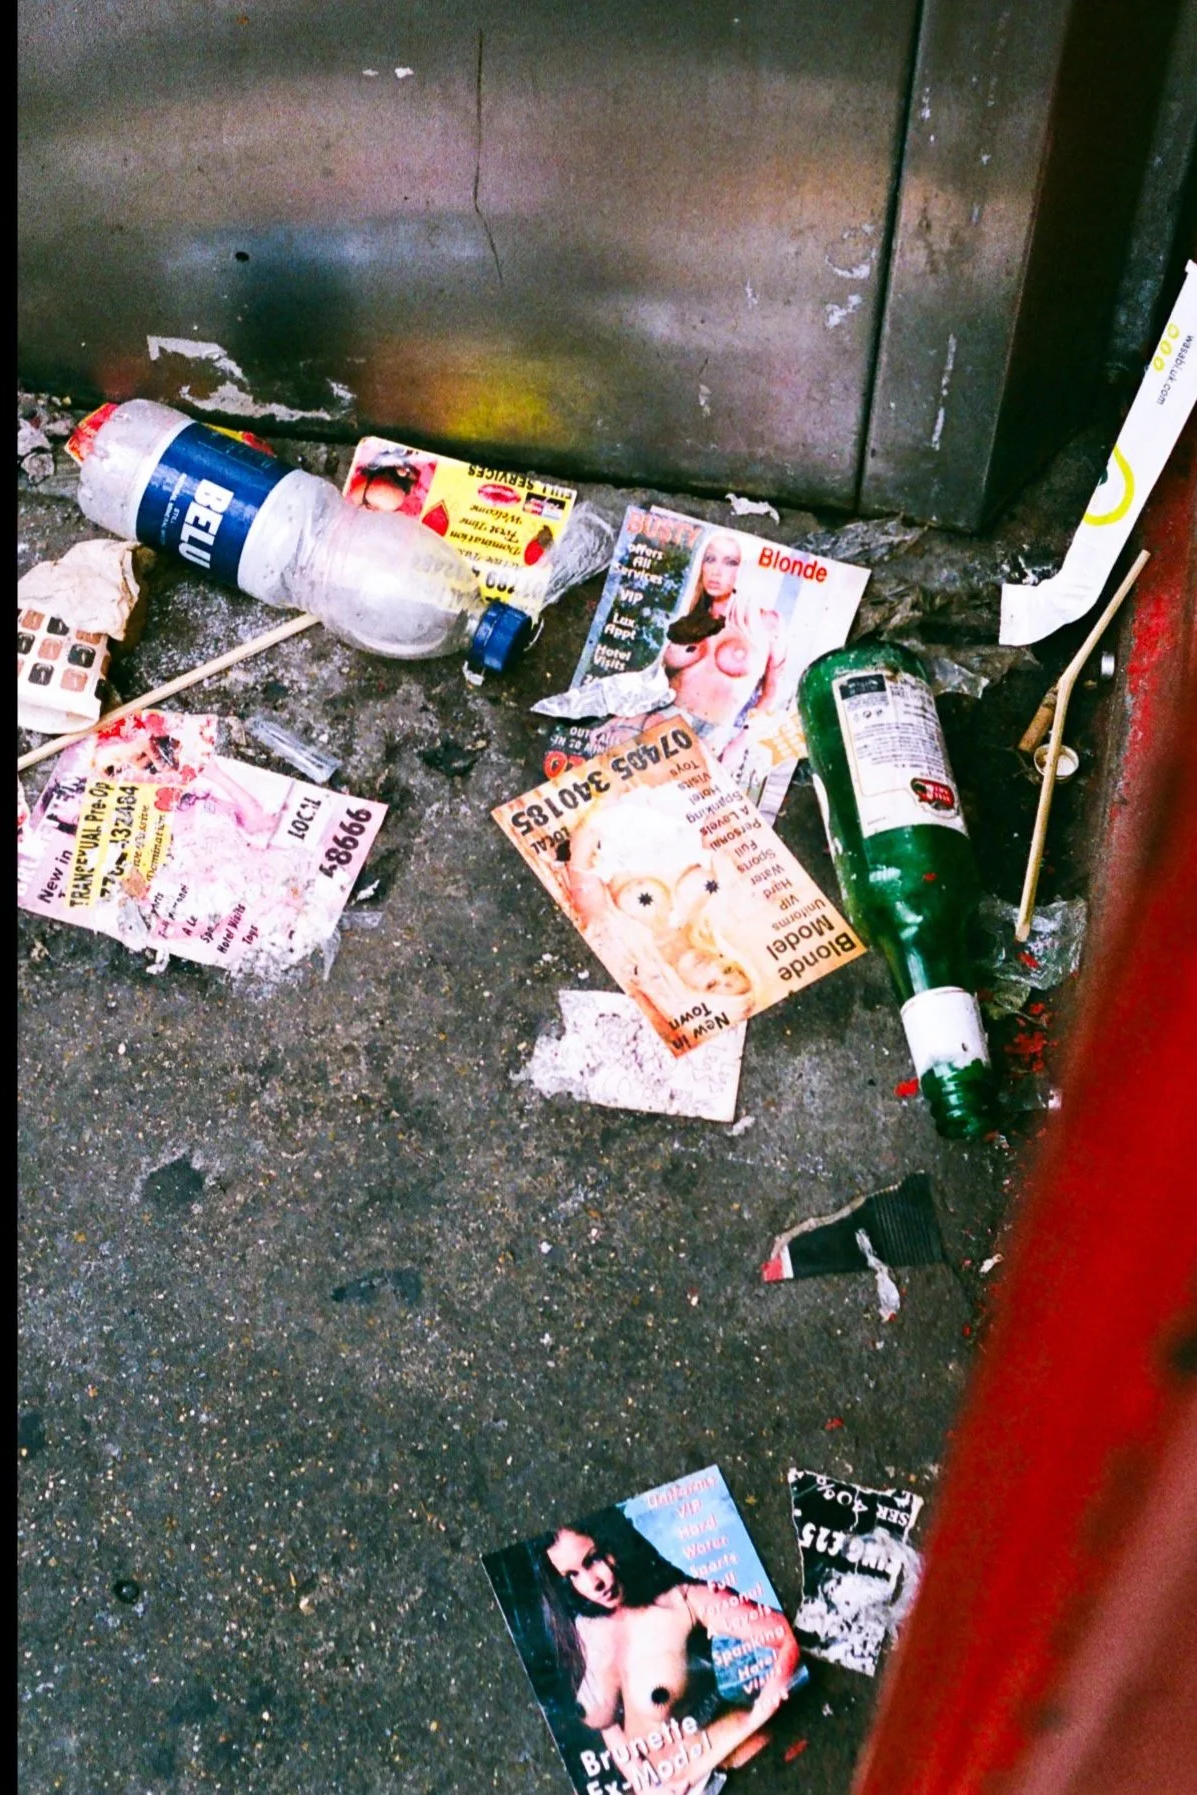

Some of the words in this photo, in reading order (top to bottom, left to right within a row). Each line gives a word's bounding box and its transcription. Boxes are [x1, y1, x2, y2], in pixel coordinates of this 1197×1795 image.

[467, 464, 535, 490] SERVICES
[178, 478, 234, 570] BELU
[469, 504, 523, 525] Welcome
[489, 525, 519, 543] First
[626, 511, 703, 547] BUSTY
[628, 543, 664, 561] offers
[633, 556, 651, 570] All
[614, 561, 663, 585] Services
[757, 547, 828, 584] Blonde
[619, 587, 643, 604] VIP
[604, 623, 637, 642] Appt
[613, 612, 636, 628] Lux
[592, 653, 626, 672] Visits
[595, 643, 631, 662] Hotel
[610, 727, 693, 781] 07405
[669, 759, 701, 778] Toys
[676, 772, 712, 793] Visits
[688, 785, 722, 805] Hotel
[510, 771, 612, 836] 340185
[685, 789, 745, 826] Spanking
[739, 808, 751, 820] A
[529, 827, 571, 856] LOCAL
[710, 818, 763, 852] Personal
[734, 840, 759, 859] Full
[736, 846, 777, 874] Sports
[37, 866, 64, 904] New
[54, 849, 73, 865] in
[750, 862, 785, 886] Water
[763, 877, 793, 899] Hard
[772, 896, 827, 932] Uniforms
[778, 895, 799, 912] VIP
[216, 927, 234, 954] Hotel
[227, 903, 246, 929] Visits
[241, 923, 260, 947] Toys
[767, 914, 836, 962] Model
[777, 931, 857, 983] Blonde
[668, 1001, 713, 1030] Town
[691, 1010, 731, 1040] New
[671, 1034, 692, 1051] in
[676, 1498, 703, 1519] VIP
[678, 1517, 717, 1541] Hard
[801, 1522, 847, 1557] £25
[683, 1535, 729, 1560] Water
[690, 1551, 739, 1579] Sports
[707, 1571, 738, 1594] Full
[698, 1580, 765, 1618] Personal
[712, 1625, 785, 1667] Spanking
[738, 1651, 778, 1681] Hotel
[579, 1715, 699, 1778] Brunette
[585, 1734, 713, 1795] Ex-Model
